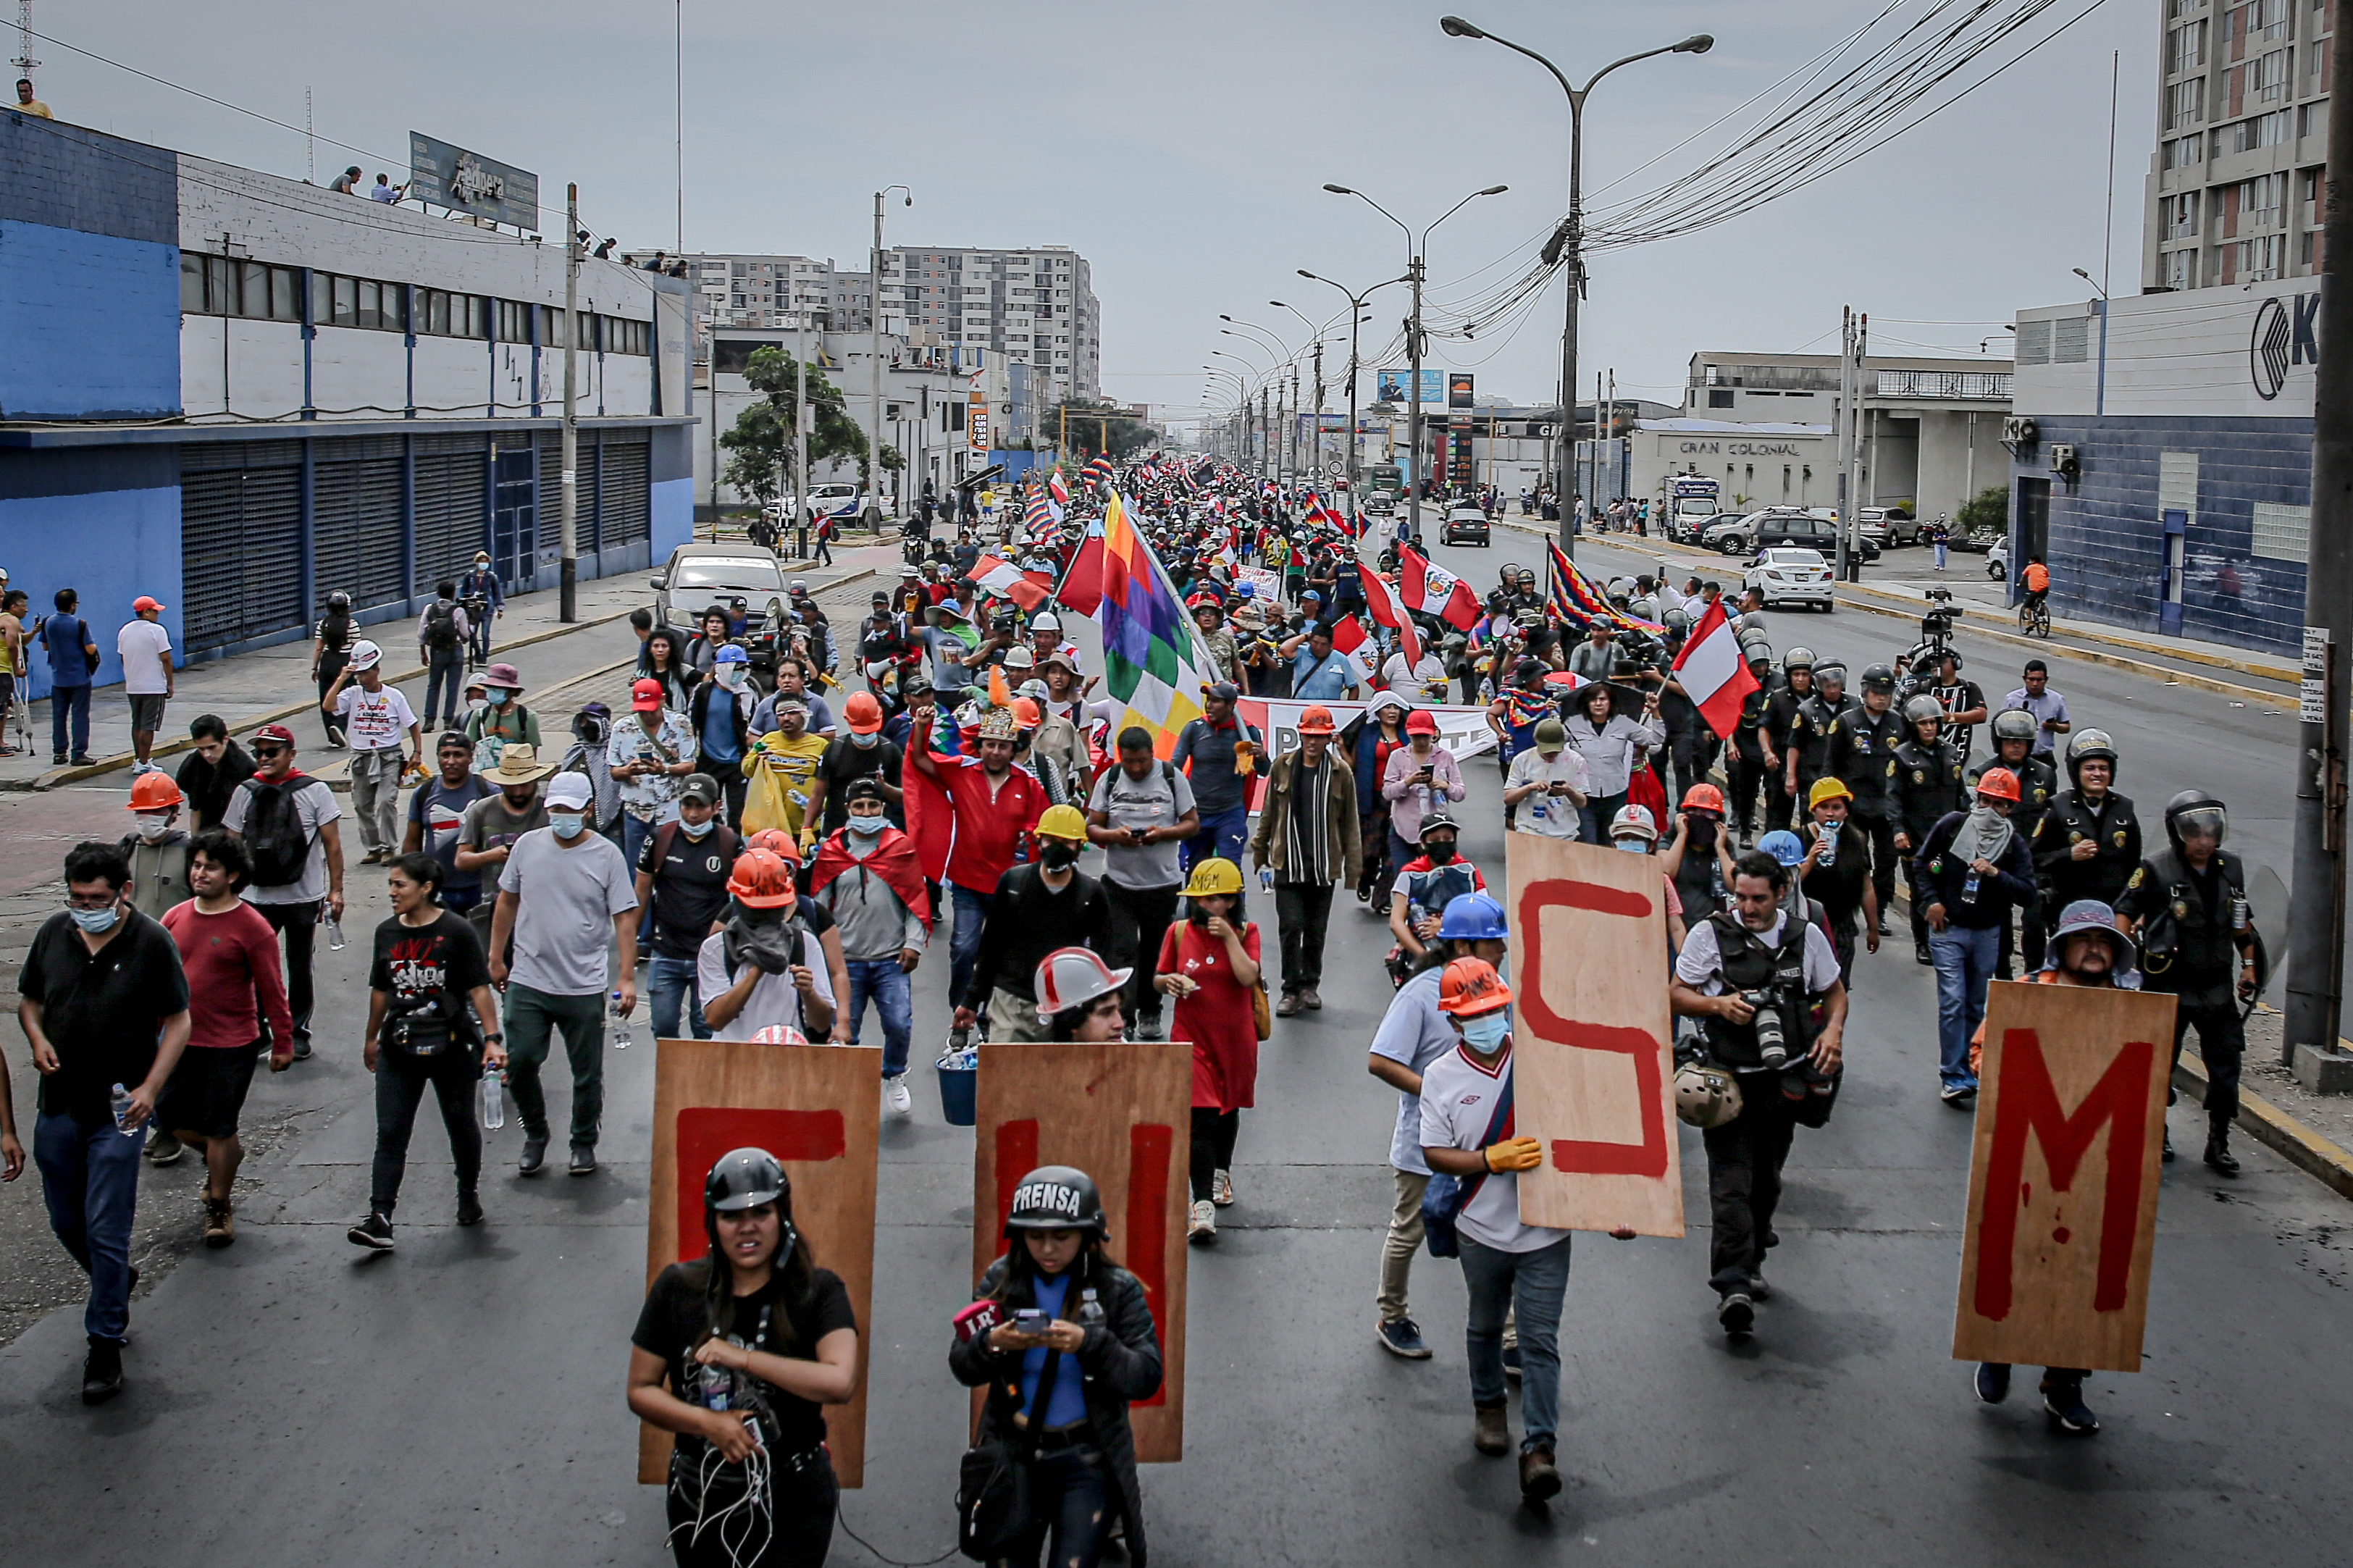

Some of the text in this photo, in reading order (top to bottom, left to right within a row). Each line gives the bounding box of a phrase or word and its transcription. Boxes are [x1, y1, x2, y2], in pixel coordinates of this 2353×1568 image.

[2291, 293, 2321, 364] K
[416, 1045, 435, 1055] CAT
[1519, 878, 1667, 1178] S
[1012, 1183, 1081, 1217] PRENSA
[1975, 1028, 2153, 1322] M
